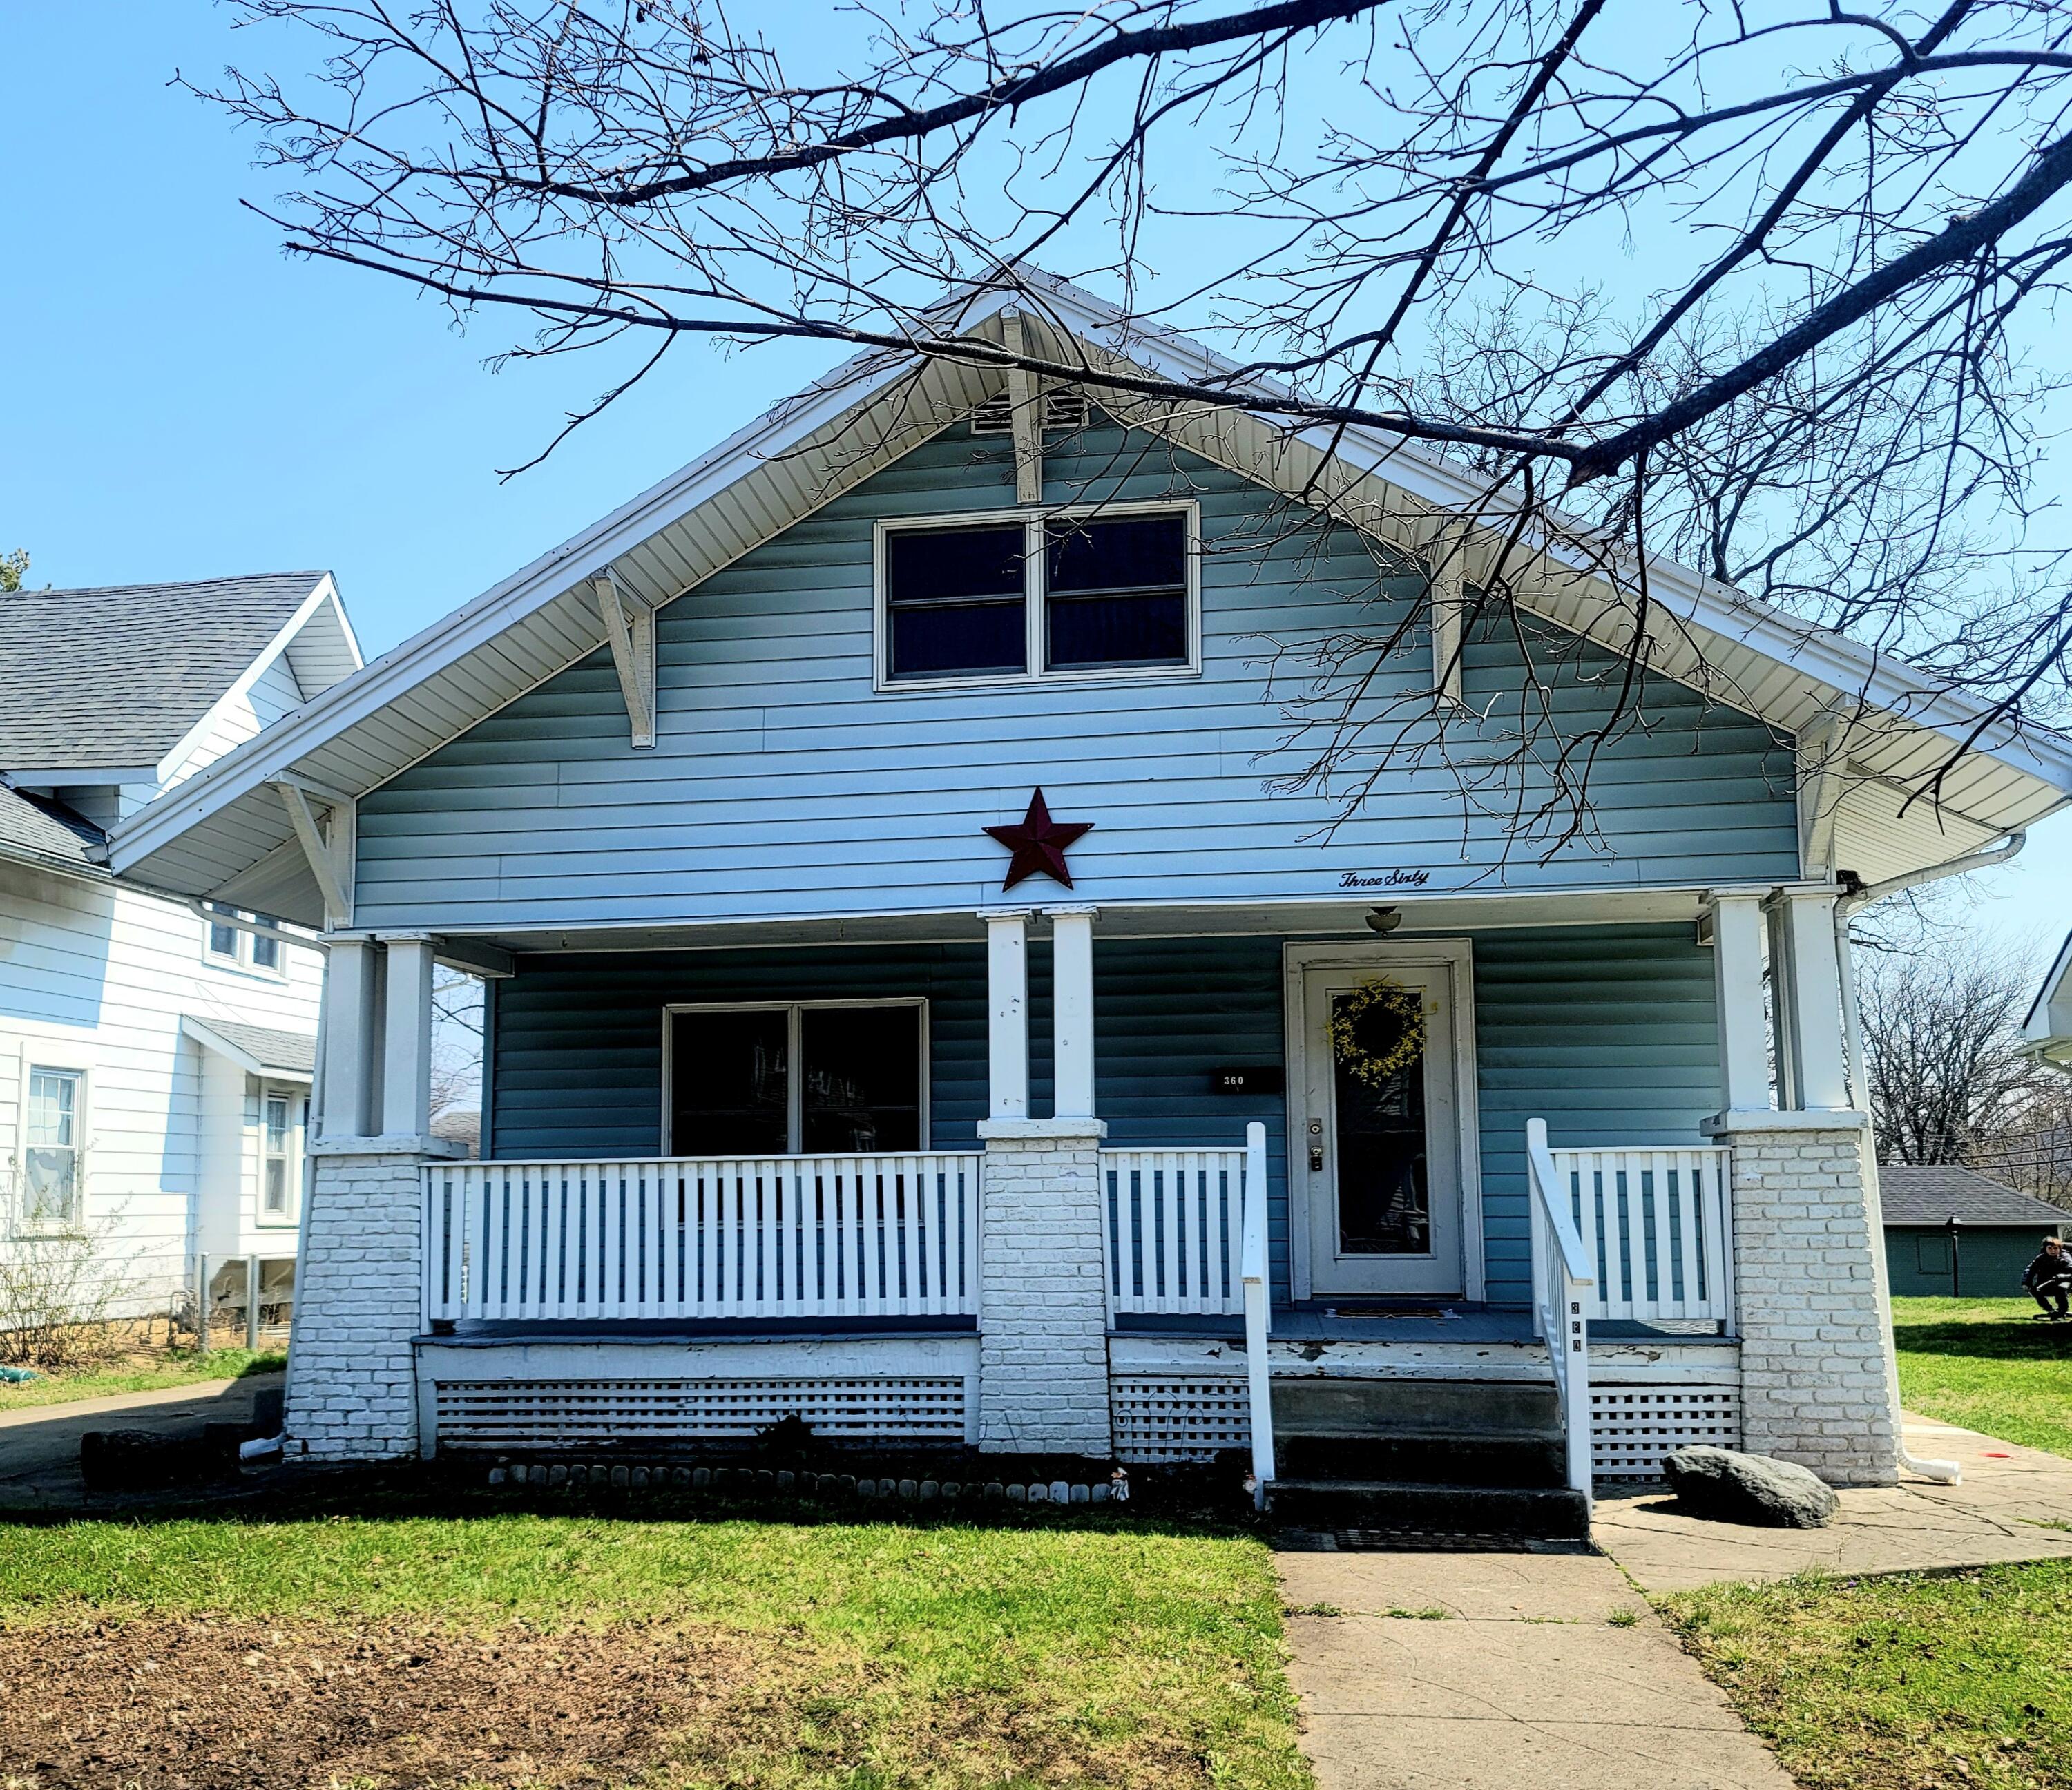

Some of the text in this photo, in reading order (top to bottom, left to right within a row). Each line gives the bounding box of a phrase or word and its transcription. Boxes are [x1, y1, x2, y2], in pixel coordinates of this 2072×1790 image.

[1339, 869, 1430, 887] Three Sixty
[1224, 1076, 1243, 1085] 360
